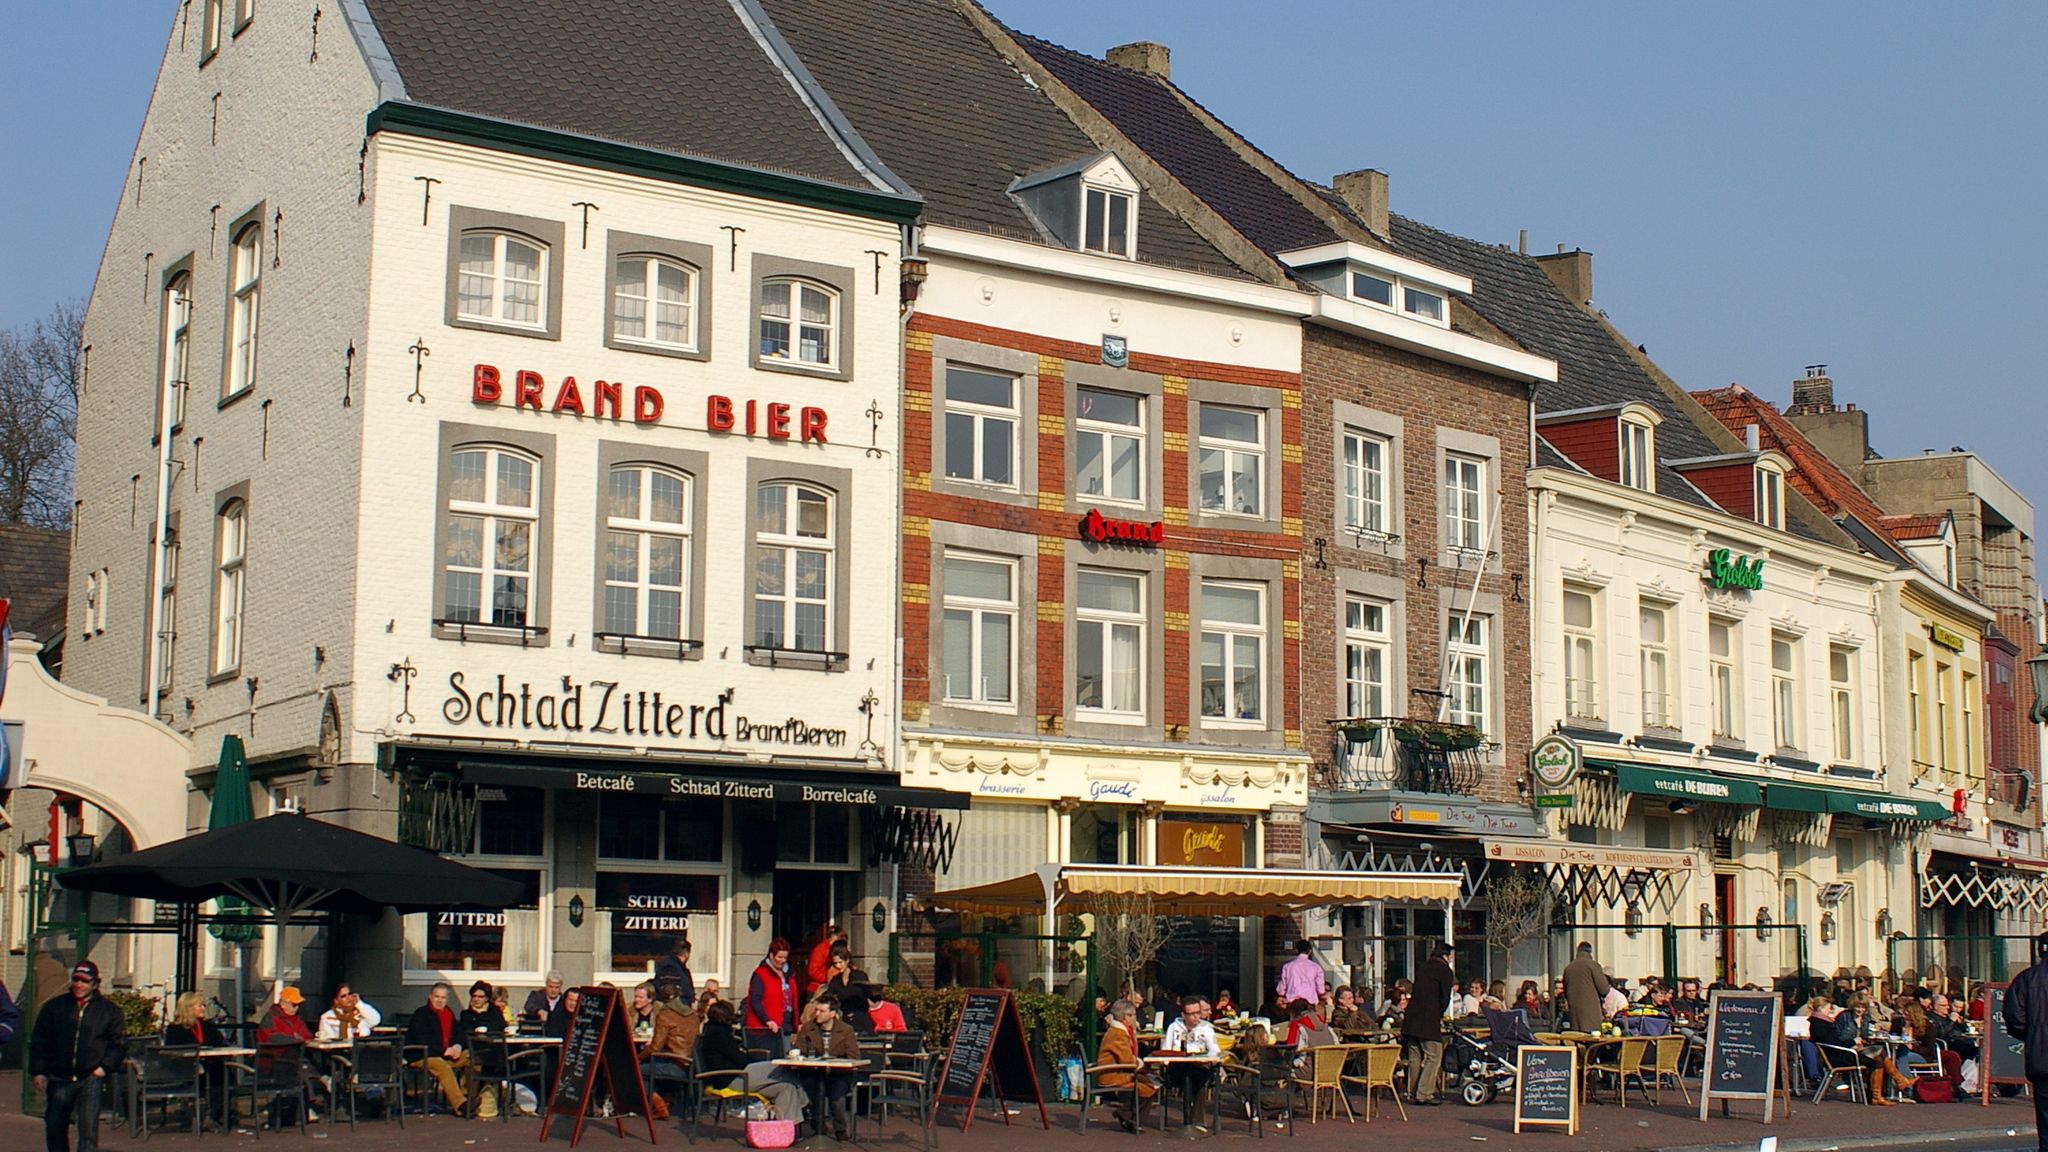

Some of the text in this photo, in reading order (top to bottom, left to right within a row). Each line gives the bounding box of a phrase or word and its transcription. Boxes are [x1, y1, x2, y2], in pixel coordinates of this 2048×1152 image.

[473, 363, 829, 445] BRAND BIER
[1083, 508, 1163, 542] Brand
[1711, 548, 1765, 590] Grolsch
[443, 671, 729, 740] Schtad Zitterd
[736, 716, 847, 747] Brand Bieren
[575, 772, 877, 804] Eetcafé Schtad Zitterd Borrelcafé
[978, 775, 1026, 794] brasserie
[627, 894, 688, 910] SCHTAD
[438, 911, 508, 927] ZITTERD
[624, 915, 690, 931] ZITTERD
